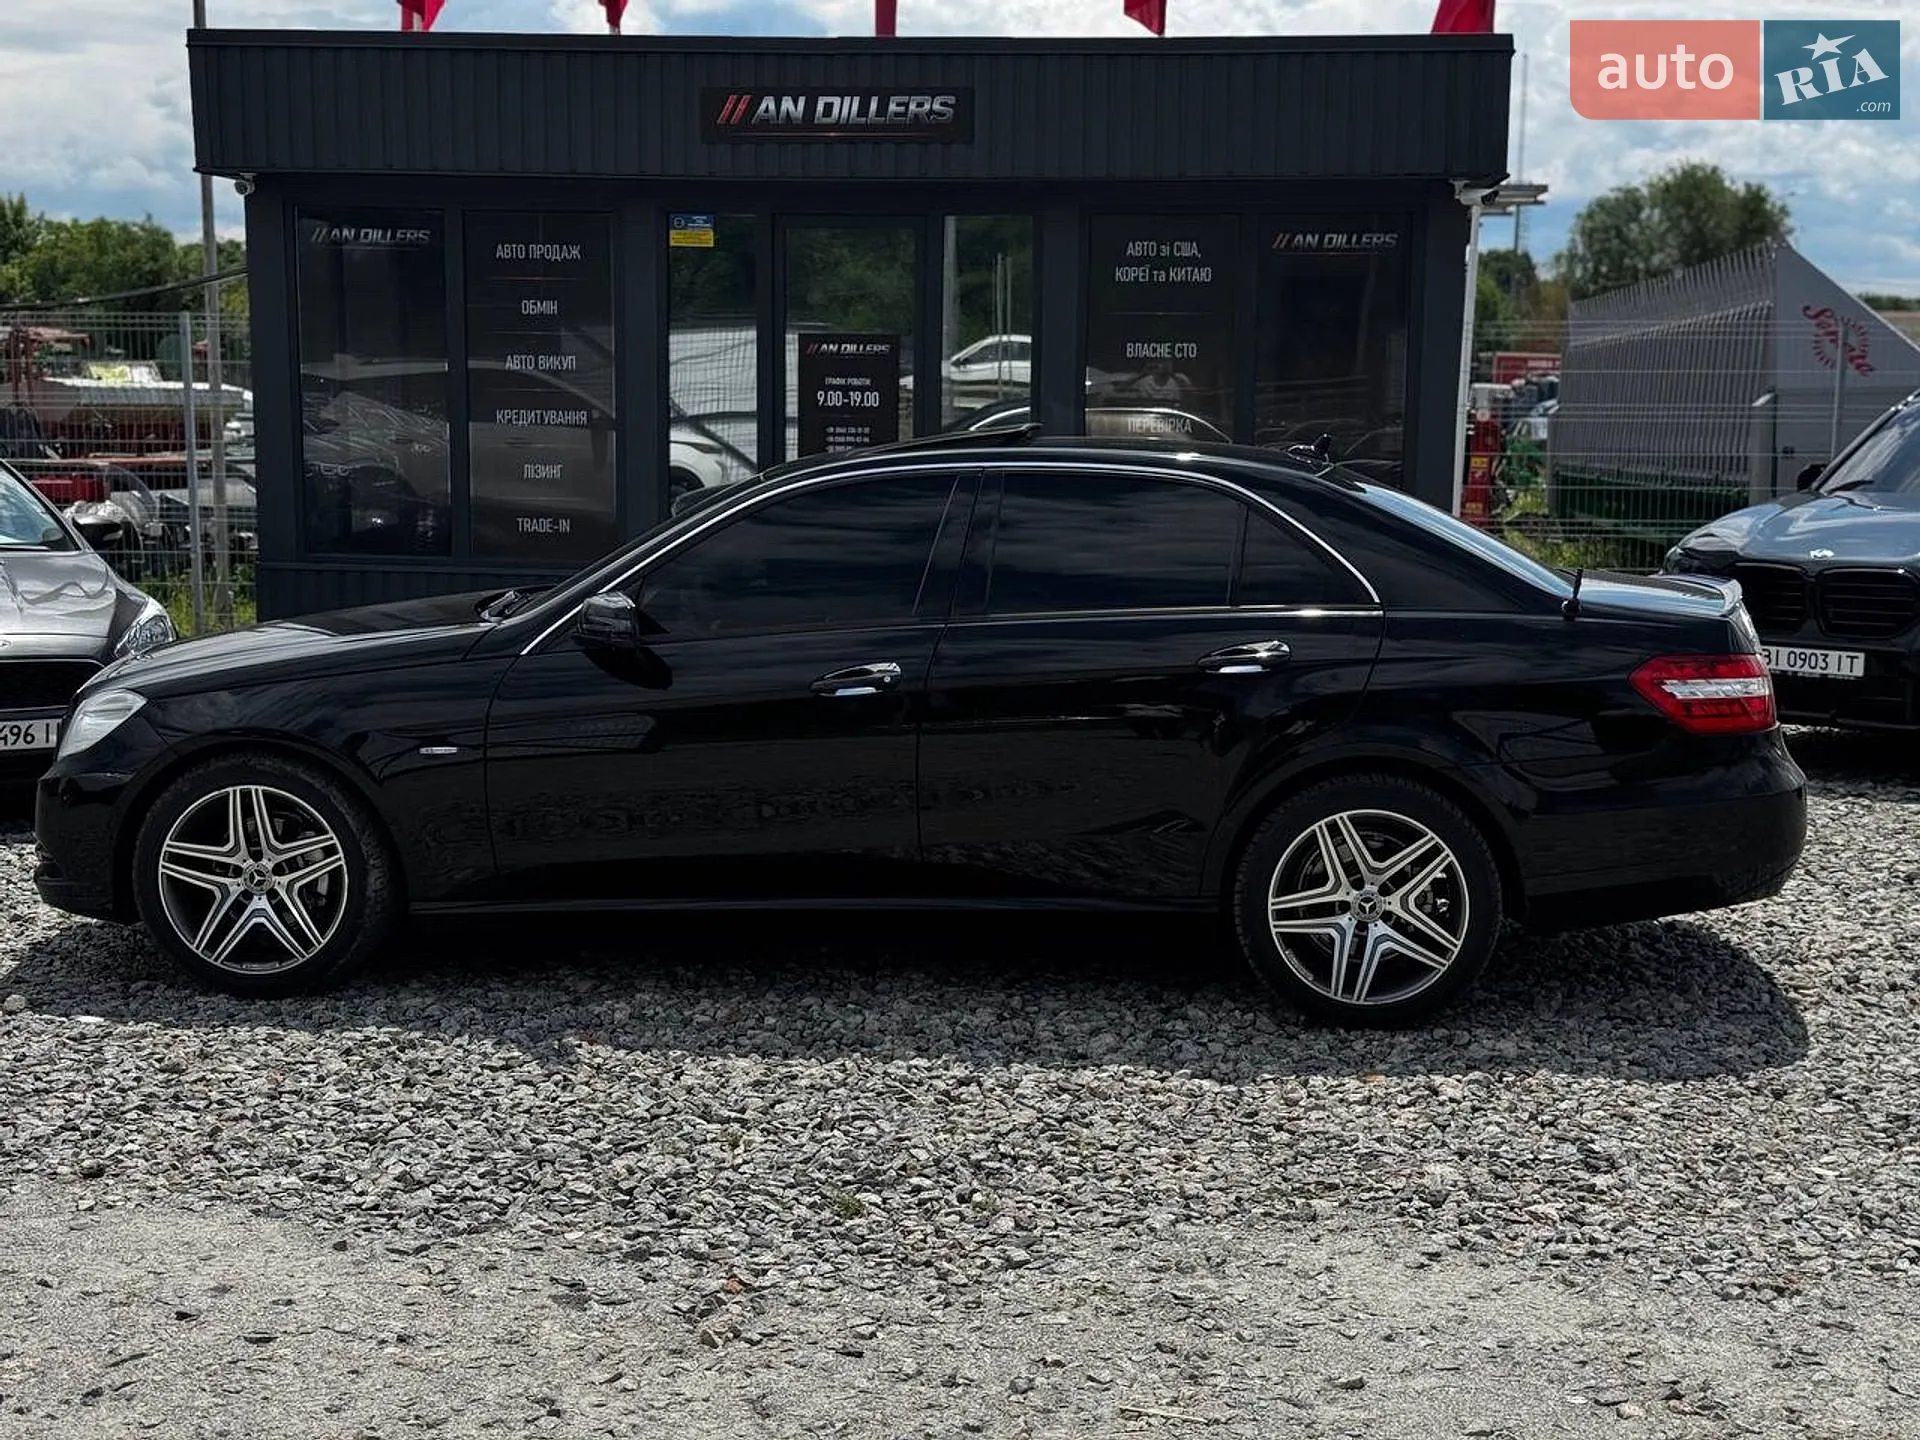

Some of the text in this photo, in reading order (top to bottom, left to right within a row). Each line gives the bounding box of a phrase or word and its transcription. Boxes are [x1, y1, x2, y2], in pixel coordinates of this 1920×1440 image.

[814, 95, 956, 125] DILLERS
[359, 227, 432, 243] DILLERS
[1322, 233, 1398, 250] DILLERS
[495, 243, 581, 262] АВТО ПРОДАЖ
[1126, 240, 1201, 258] АВТО зі США,
[1115, 264, 1212, 282] КОРЕЇ та КИТАЮ
[521, 299, 558, 315] ОБМІН
[1126, 342, 1197, 358] ВЛАСНЕ СТО
[505, 354, 576, 372] АВТО ВИКУП
[817, 391, 880, 407] 9.00-19.00
[496, 409, 588, 426] КРЕДИТУВАННЯ
[1127, 416, 1193, 434] ПЕРЕВІРКА
[523, 464, 563, 480] ЛІЗИНГ
[516, 518, 570, 533] TRADE-IN
[1787, 650, 1829, 671] 0903
[1837, 653, 1860, 673] IT
